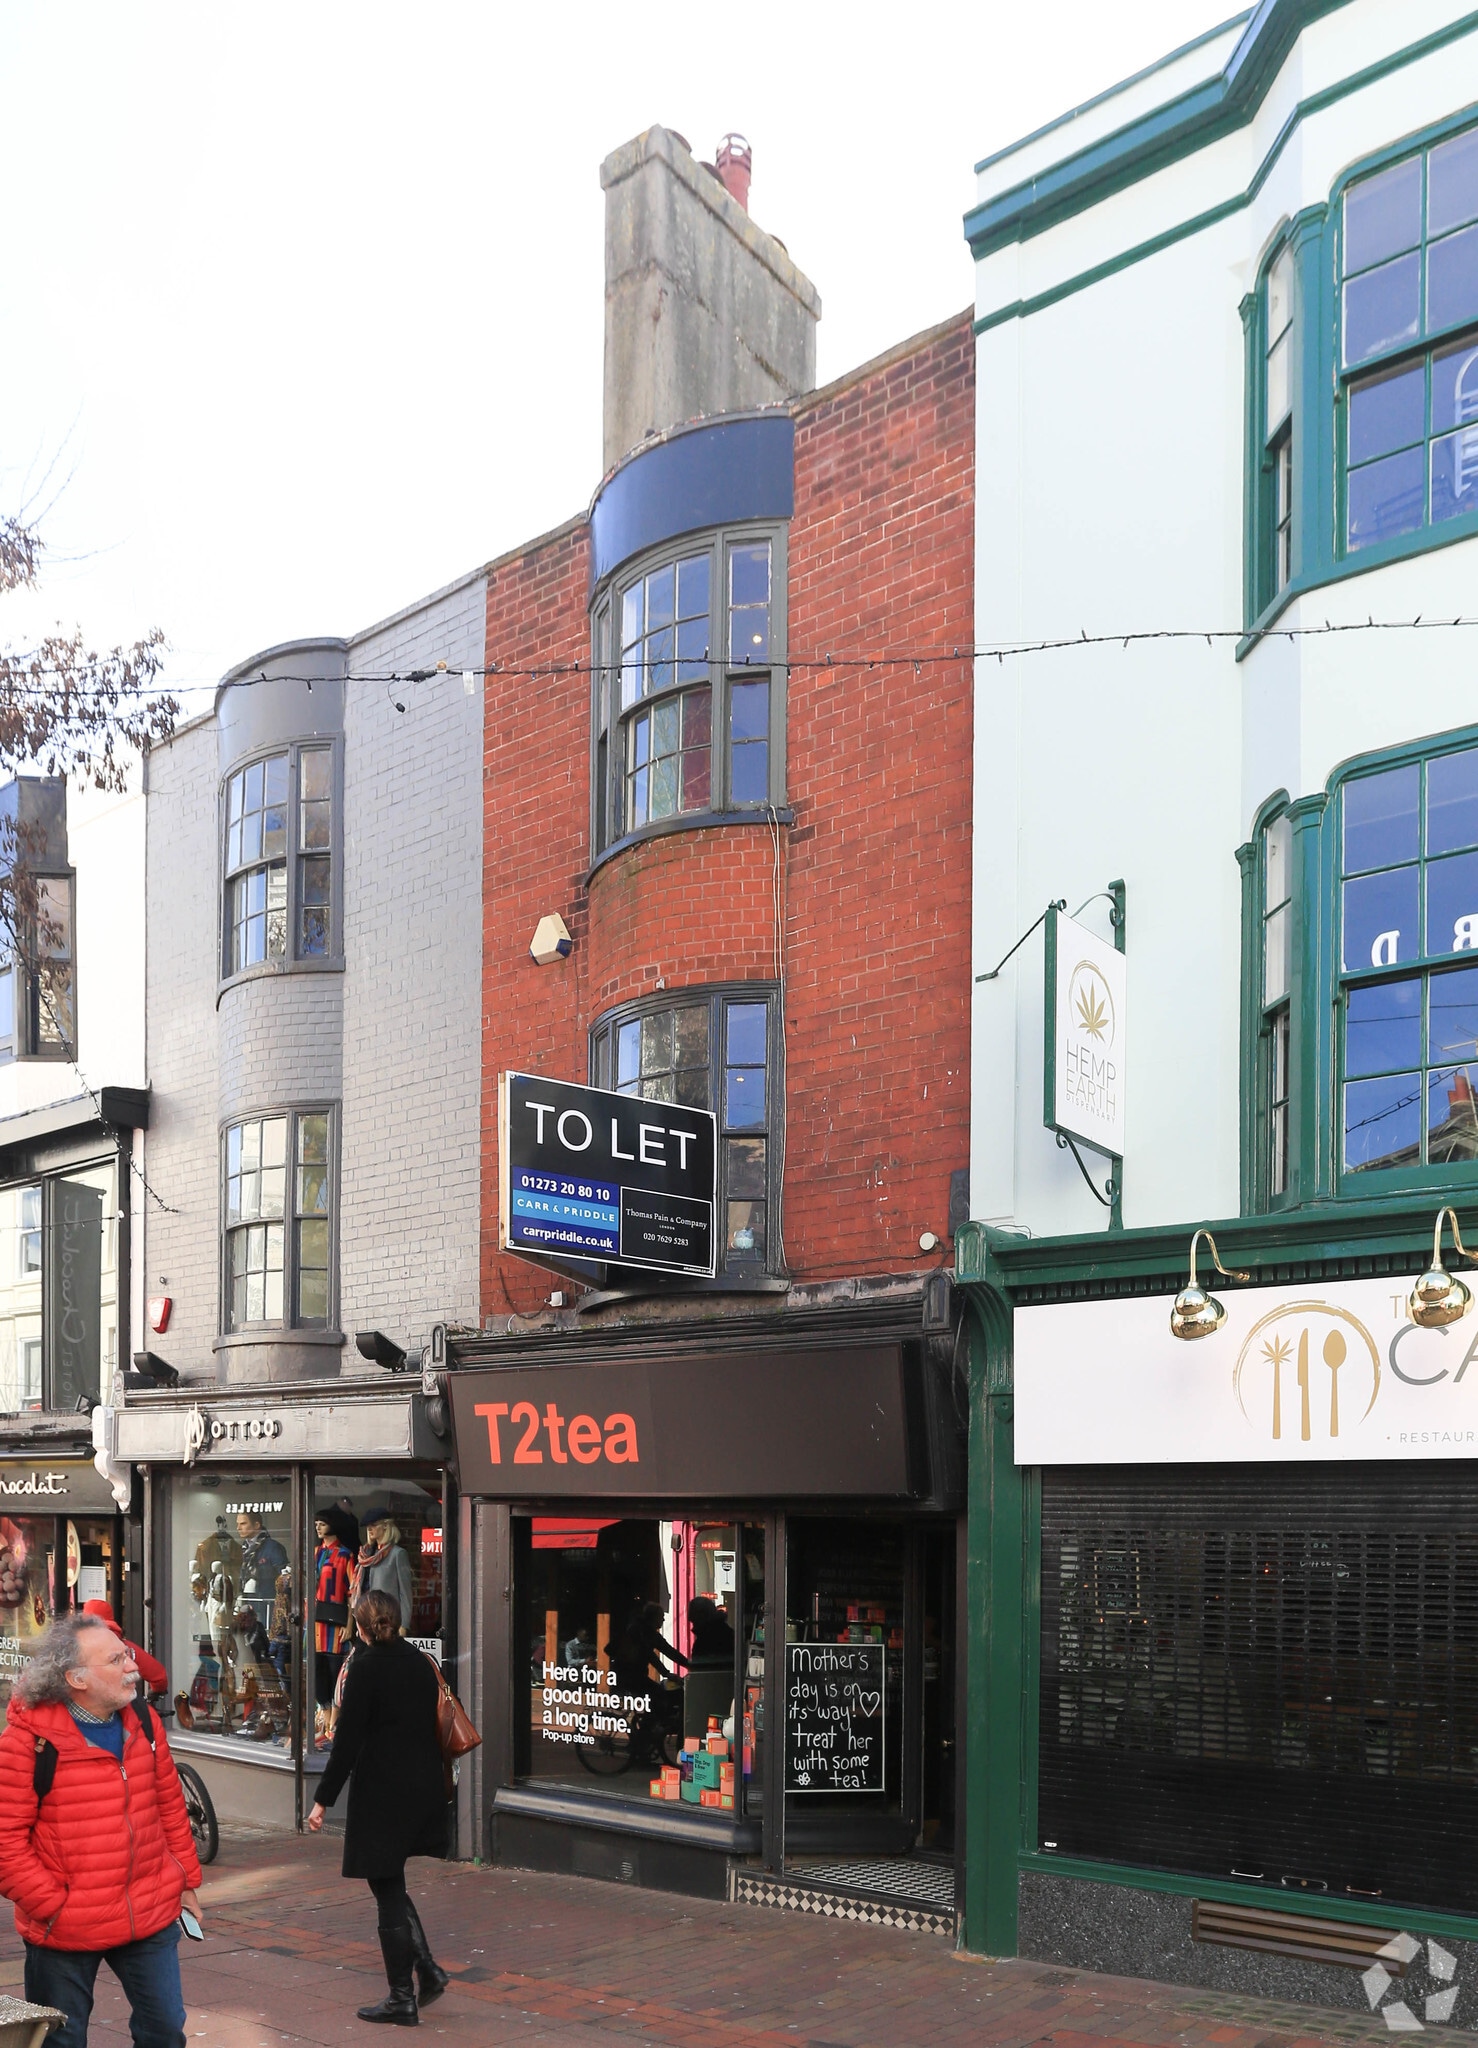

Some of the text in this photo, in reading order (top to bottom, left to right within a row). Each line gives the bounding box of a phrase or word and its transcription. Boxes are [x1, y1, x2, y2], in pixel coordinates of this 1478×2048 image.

[1066, 1038, 1116, 1089] HEMP
[1066, 1068, 1116, 1116] EARTH
[1066, 1093, 1116, 1124] DISPENSARY
[525, 1101, 697, 1170] TO LET
[521, 1175, 610, 1201] 01273 20 80 10
[517, 1198, 615, 1222] CARR & PRIDDLE
[625, 1208, 653, 1219] Thomas
[654, 1213, 669, 1222] Pain
[675, 1217, 708, 1230] Company
[523, 1227, 613, 1248] carrpriddle.co.uk
[643, 1232, 689, 1247] 020 7629 5283
[474, 1401, 640, 1464] T2tea
[412, 1639, 437, 1650] SALE
[542, 1660, 617, 1686] Here for a
[792, 1647, 869, 1673] Mother's
[542, 1686, 651, 1713] good time not
[790, 1676, 862, 1712] day is on
[542, 1706, 631, 1734] a long time.
[788, 1697, 857, 1732] its way!
[542, 1728, 595, 1745] Pop-up store
[792, 1722, 874, 1751] treat her
[793, 1750, 870, 1771] with some
[829, 1769, 868, 1788] tea!
